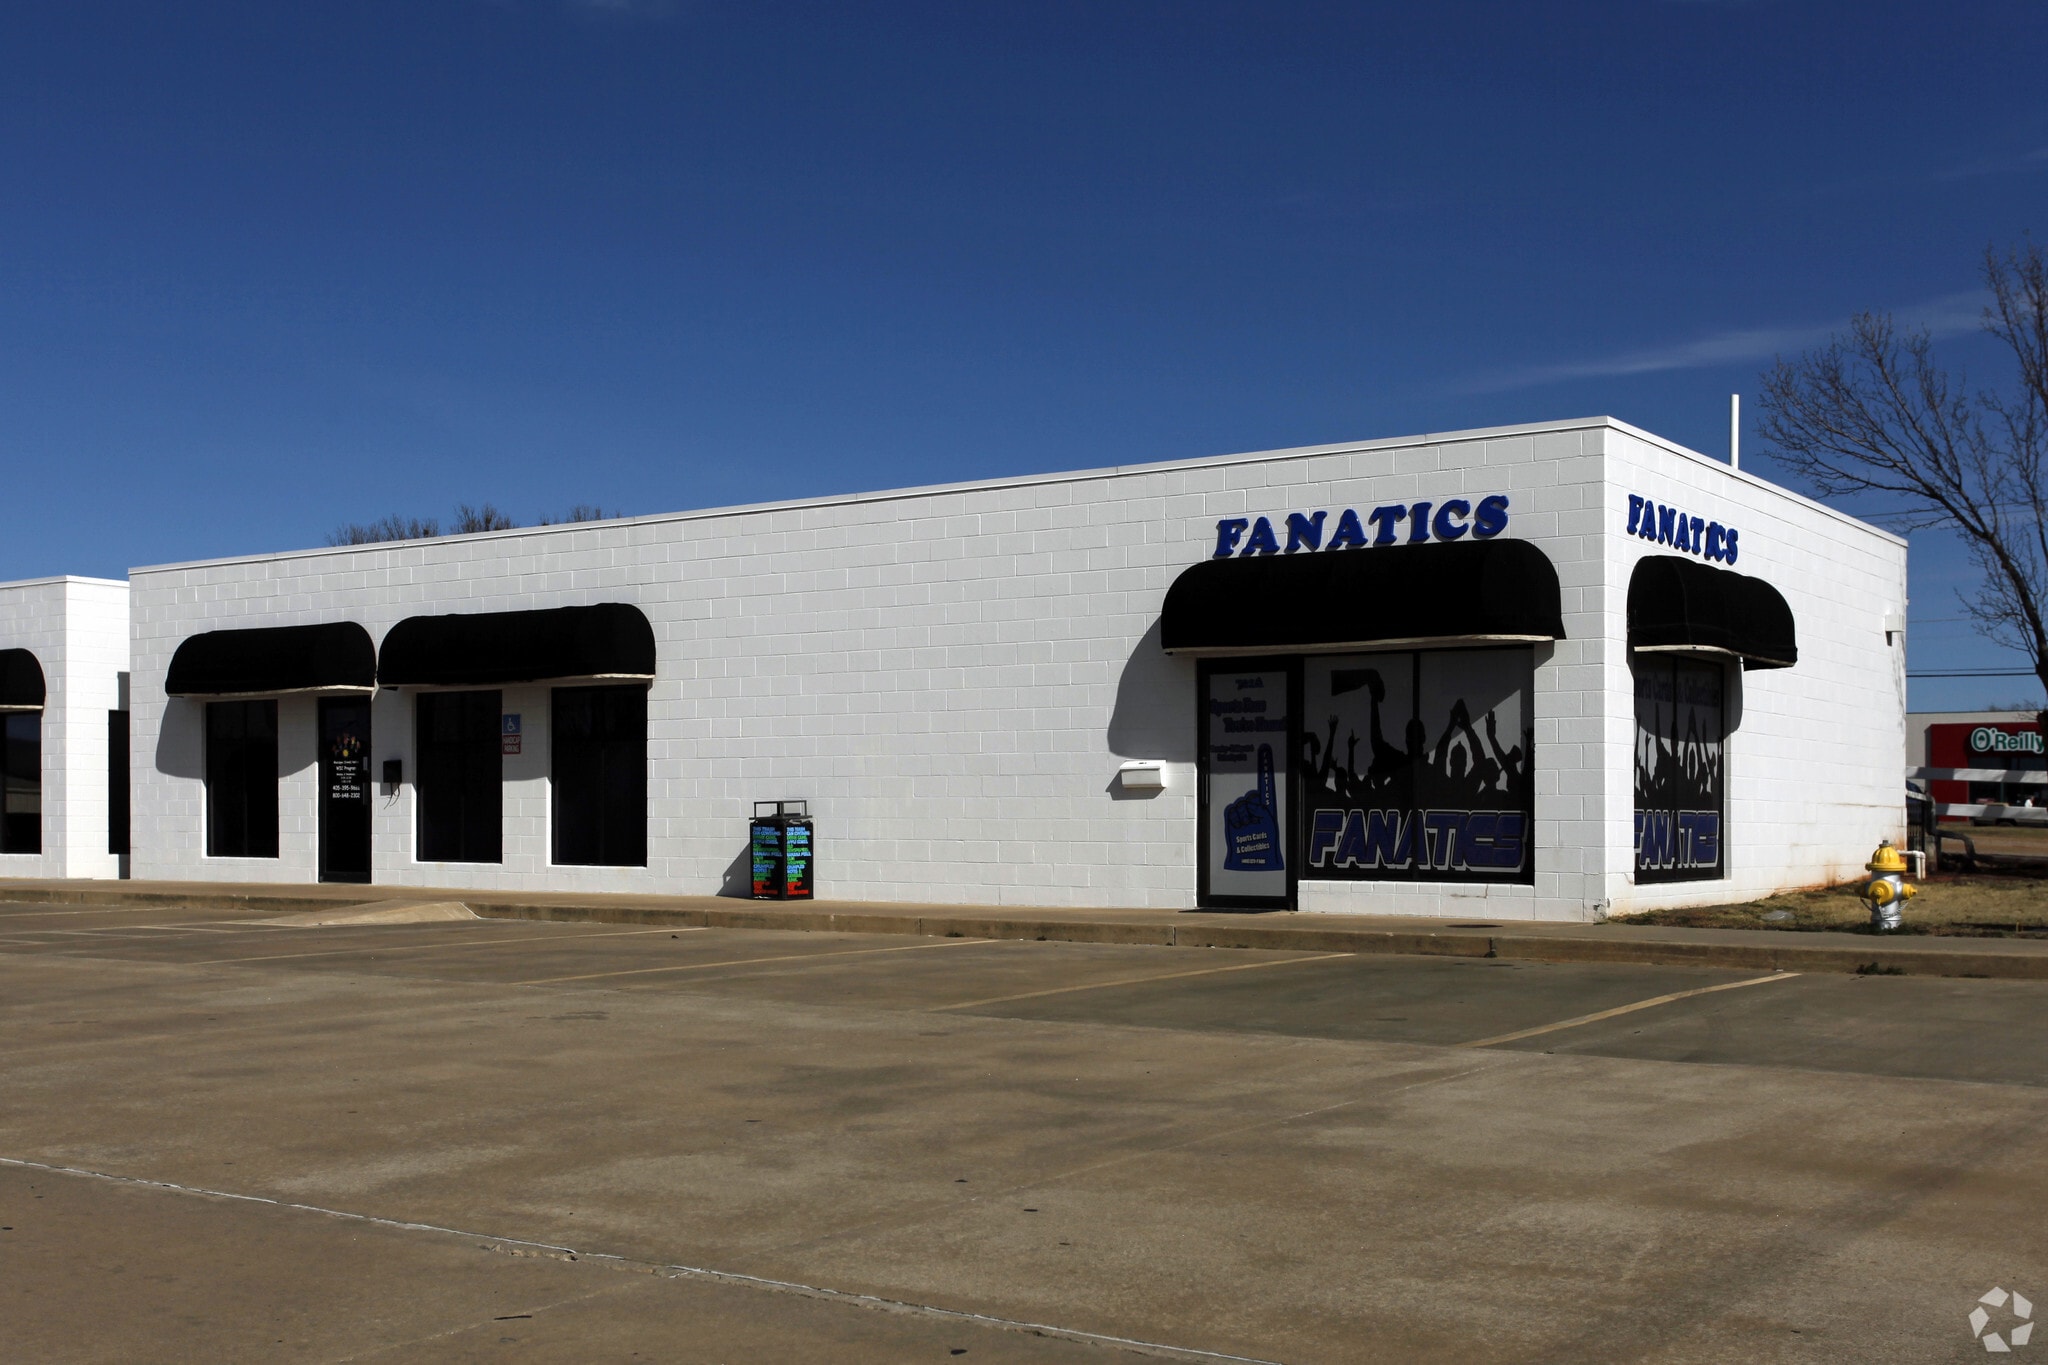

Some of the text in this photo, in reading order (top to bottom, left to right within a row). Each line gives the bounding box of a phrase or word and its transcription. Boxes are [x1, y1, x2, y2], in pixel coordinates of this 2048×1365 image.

[1214, 495, 1509, 558] FANATICS
[1627, 494, 1738, 565] FANATICS
[1971, 727, 2045, 753] O'Reilly
[1236, 832, 1267, 843] Sports Cards
[1240, 842, 1270, 853] Collectibles
[1309, 809, 1529, 872] FANATICS
